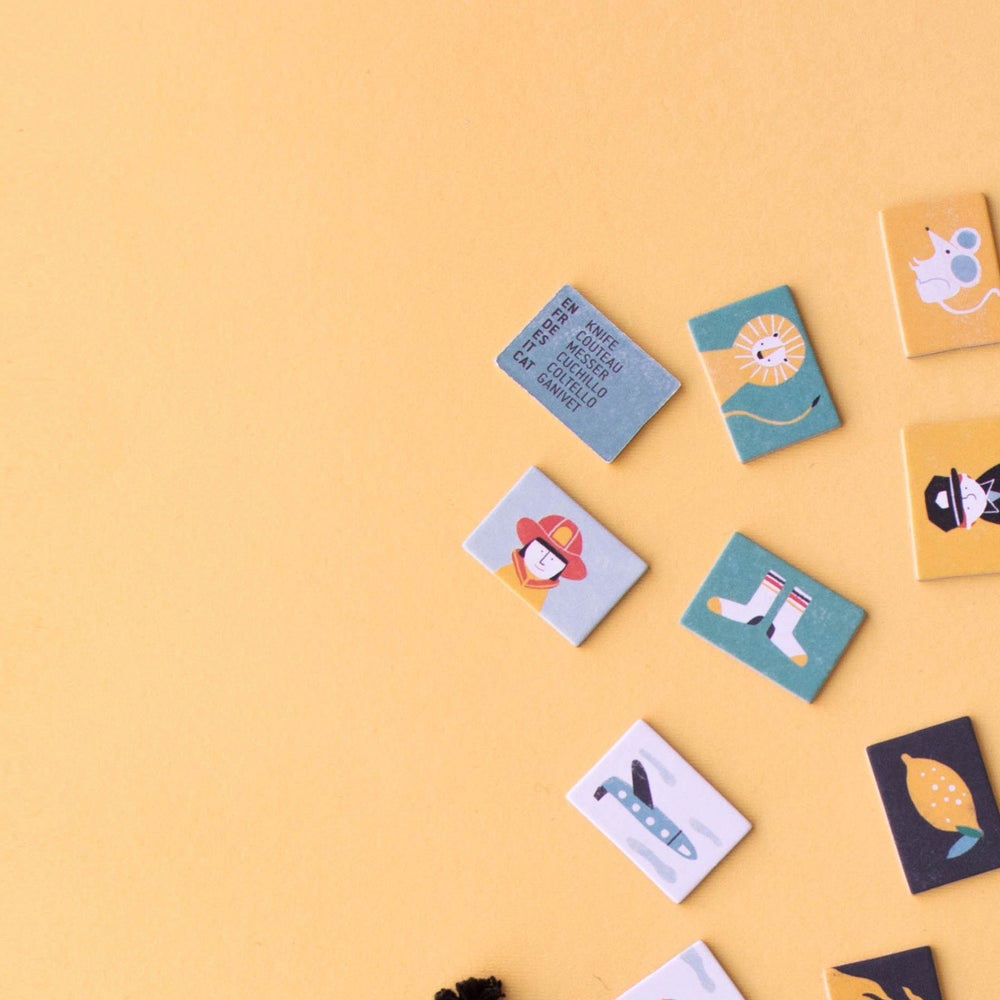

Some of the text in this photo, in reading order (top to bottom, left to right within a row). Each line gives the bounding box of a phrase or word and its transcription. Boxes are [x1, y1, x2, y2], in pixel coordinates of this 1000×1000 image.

[542, 318, 610, 381] DE MESSER
[551, 308, 624, 373] FR COUTEAU
[561, 298, 619, 351] EN KNIFE
[513, 350, 581, 412] CAT GANIVET
[522, 340, 597, 408] IT COLTELLO
[532, 329, 608, 398] ES CUCHILLO
